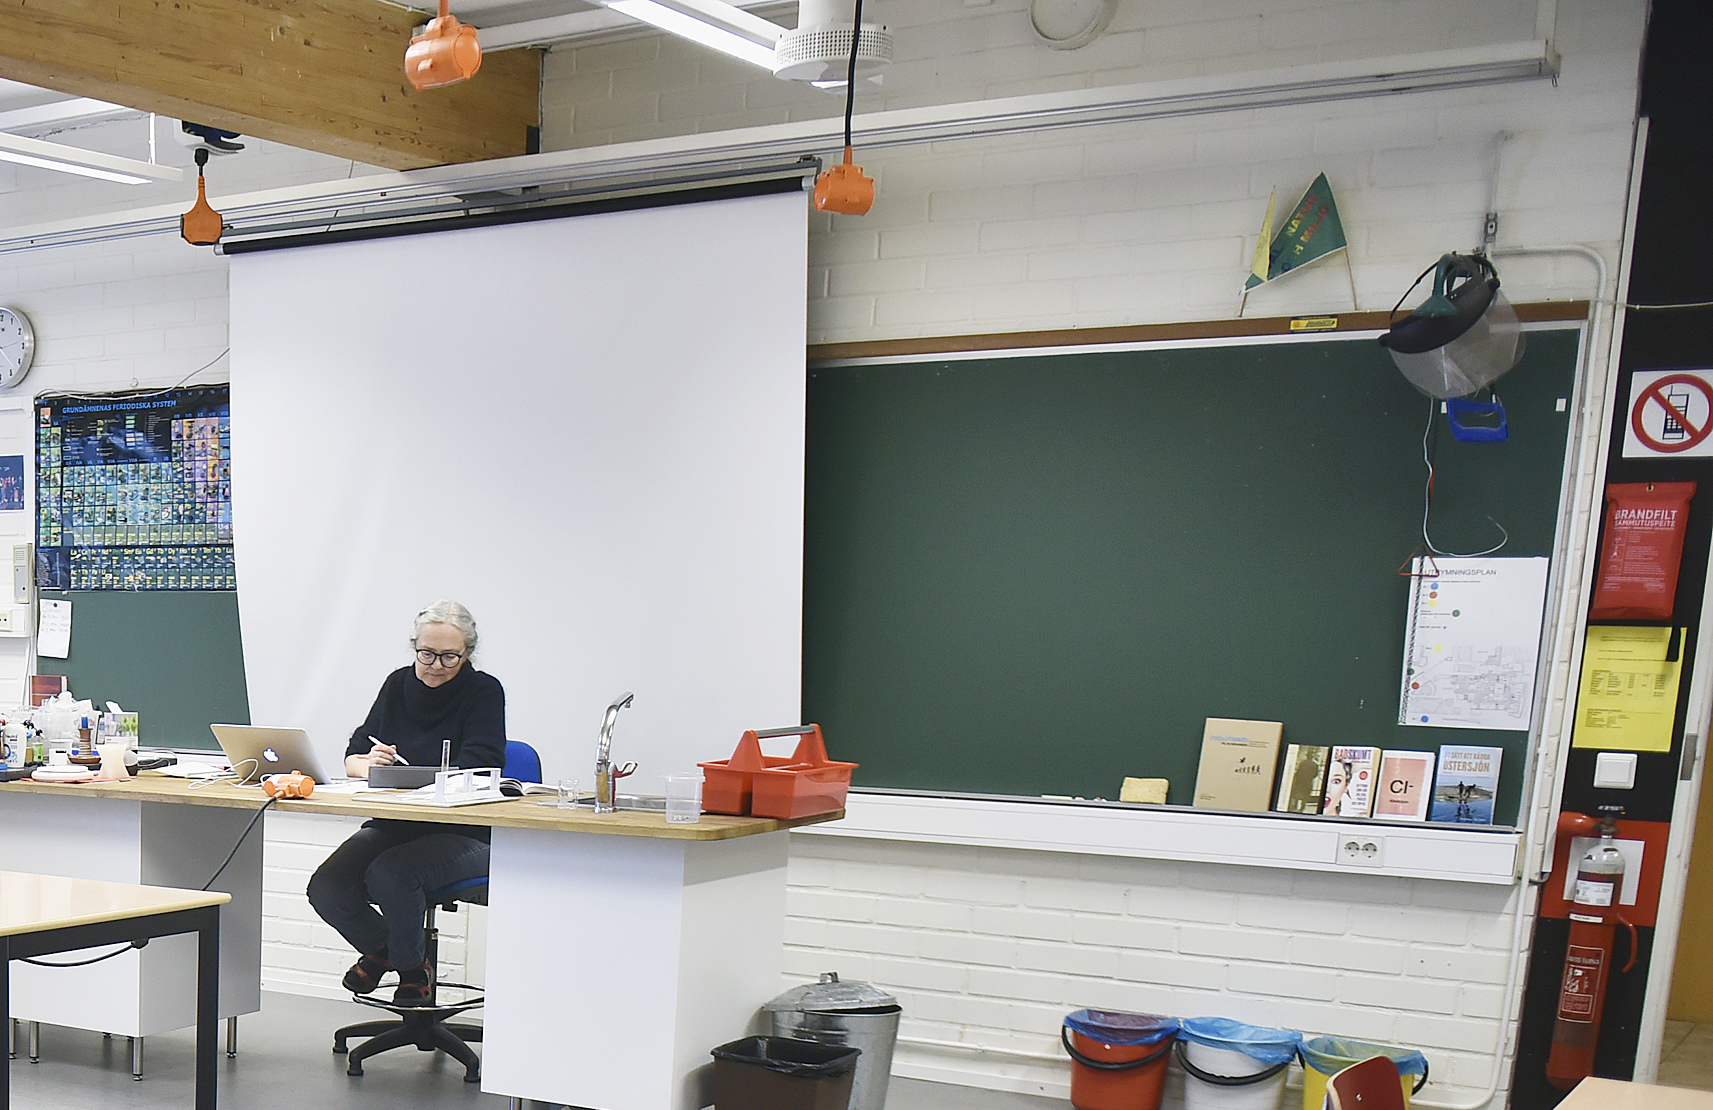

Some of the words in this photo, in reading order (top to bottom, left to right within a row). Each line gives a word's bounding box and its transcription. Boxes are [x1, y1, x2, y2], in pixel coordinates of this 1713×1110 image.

[113, 401, 151, 411] PERIODISKA
[152, 400, 177, 408] SYSTEM
[1614, 509, 1678, 520] BRANDFILT
[1614, 519, 1676, 528] SAMMUTUSPEITE
